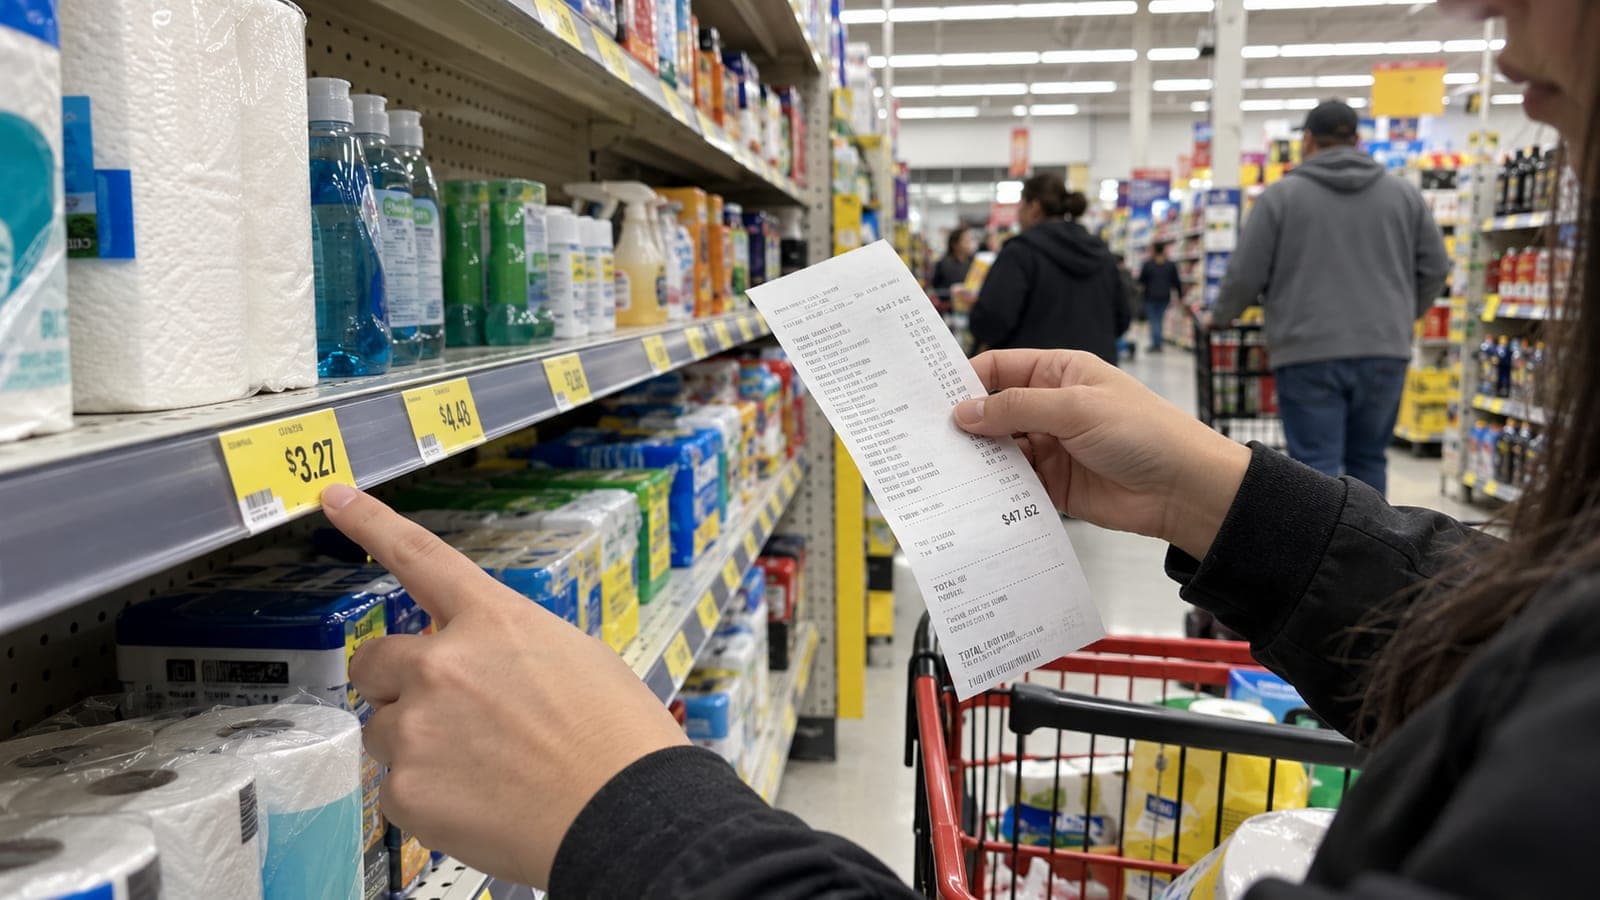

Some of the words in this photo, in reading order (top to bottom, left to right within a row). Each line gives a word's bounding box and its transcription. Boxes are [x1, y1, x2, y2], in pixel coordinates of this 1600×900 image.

[439, 400, 471, 432] $4.48
[285, 438, 336, 483] $3.27
[1001, 503, 1040, 526] $47.62
[933, 579, 957, 593] TOTAL
